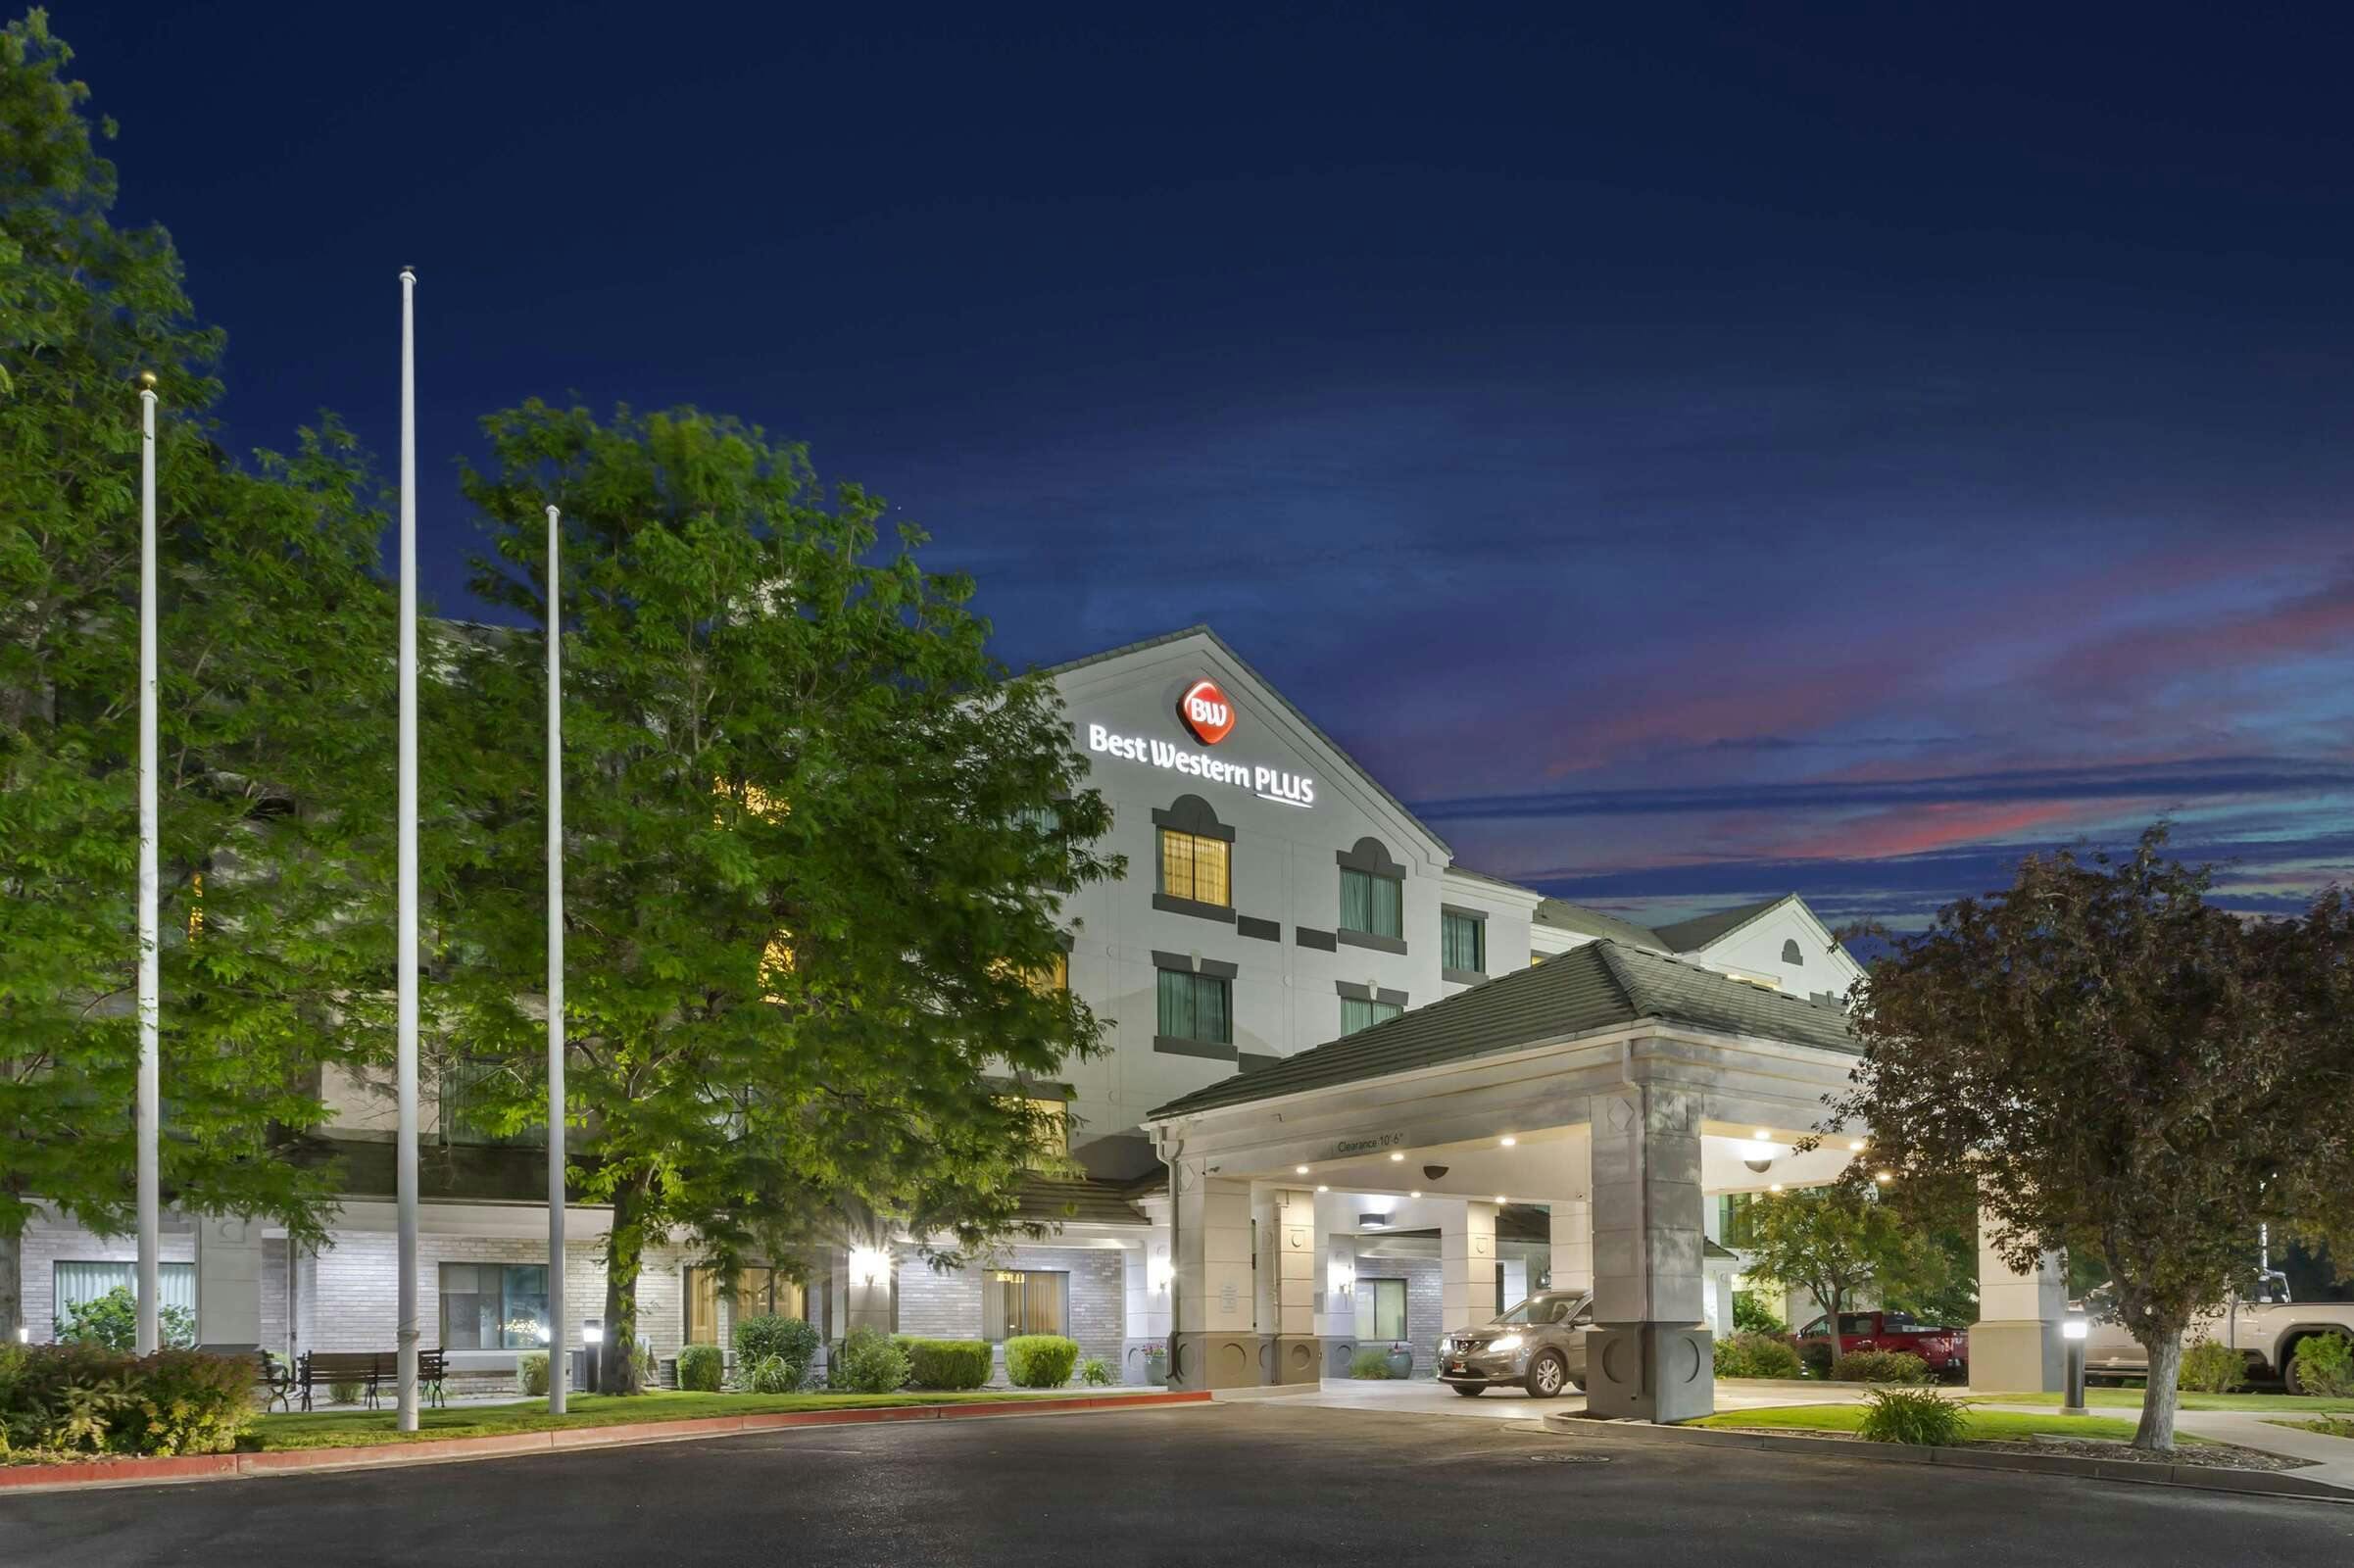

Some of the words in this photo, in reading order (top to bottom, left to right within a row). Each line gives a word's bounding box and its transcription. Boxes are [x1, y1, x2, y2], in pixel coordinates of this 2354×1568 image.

[1191, 698, 1227, 726] BW
[1089, 724, 1147, 762] Best
[1150, 740, 1250, 787] Western
[1254, 766, 1314, 803] PLUS
